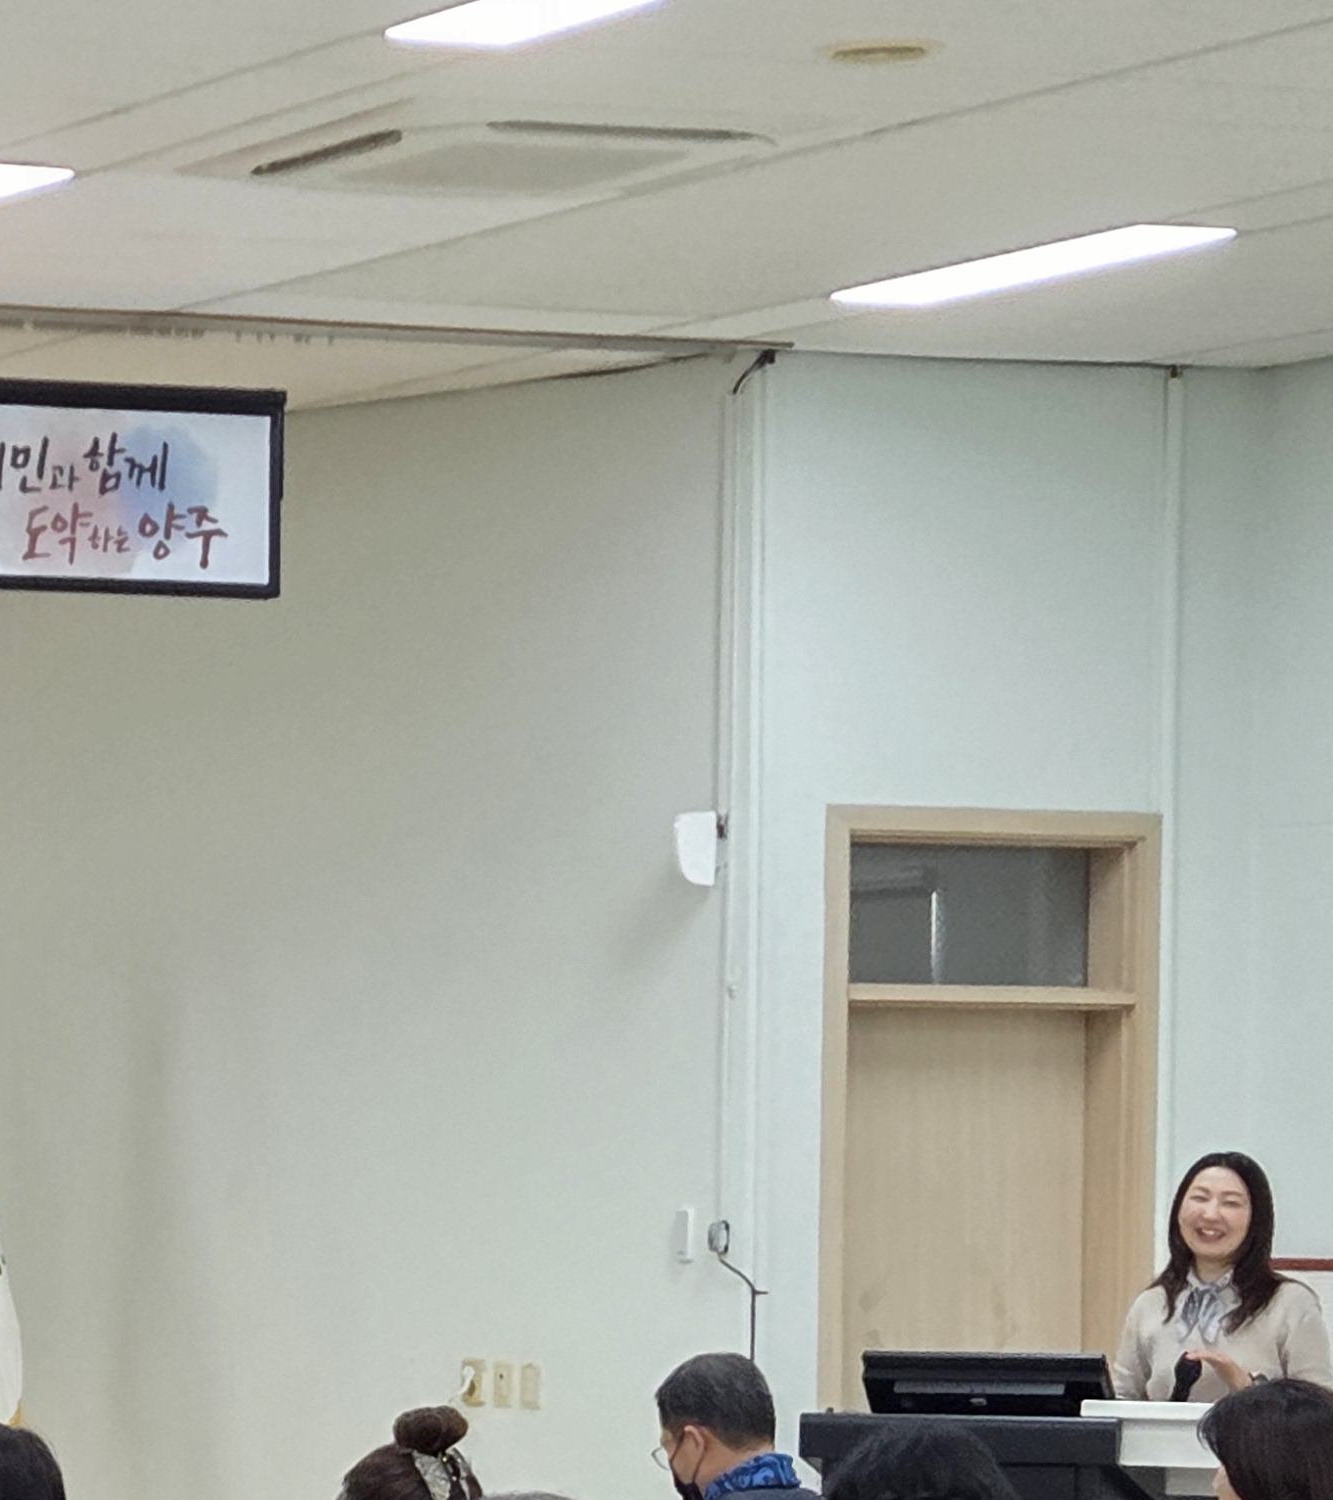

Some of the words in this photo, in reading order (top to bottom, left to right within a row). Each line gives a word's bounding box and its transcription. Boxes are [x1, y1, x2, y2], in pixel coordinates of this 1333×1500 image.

[85, 431, 169, 497] 함께
[21, 505, 131, 564] 도약하는
[138, 506, 228, 568] 양주
